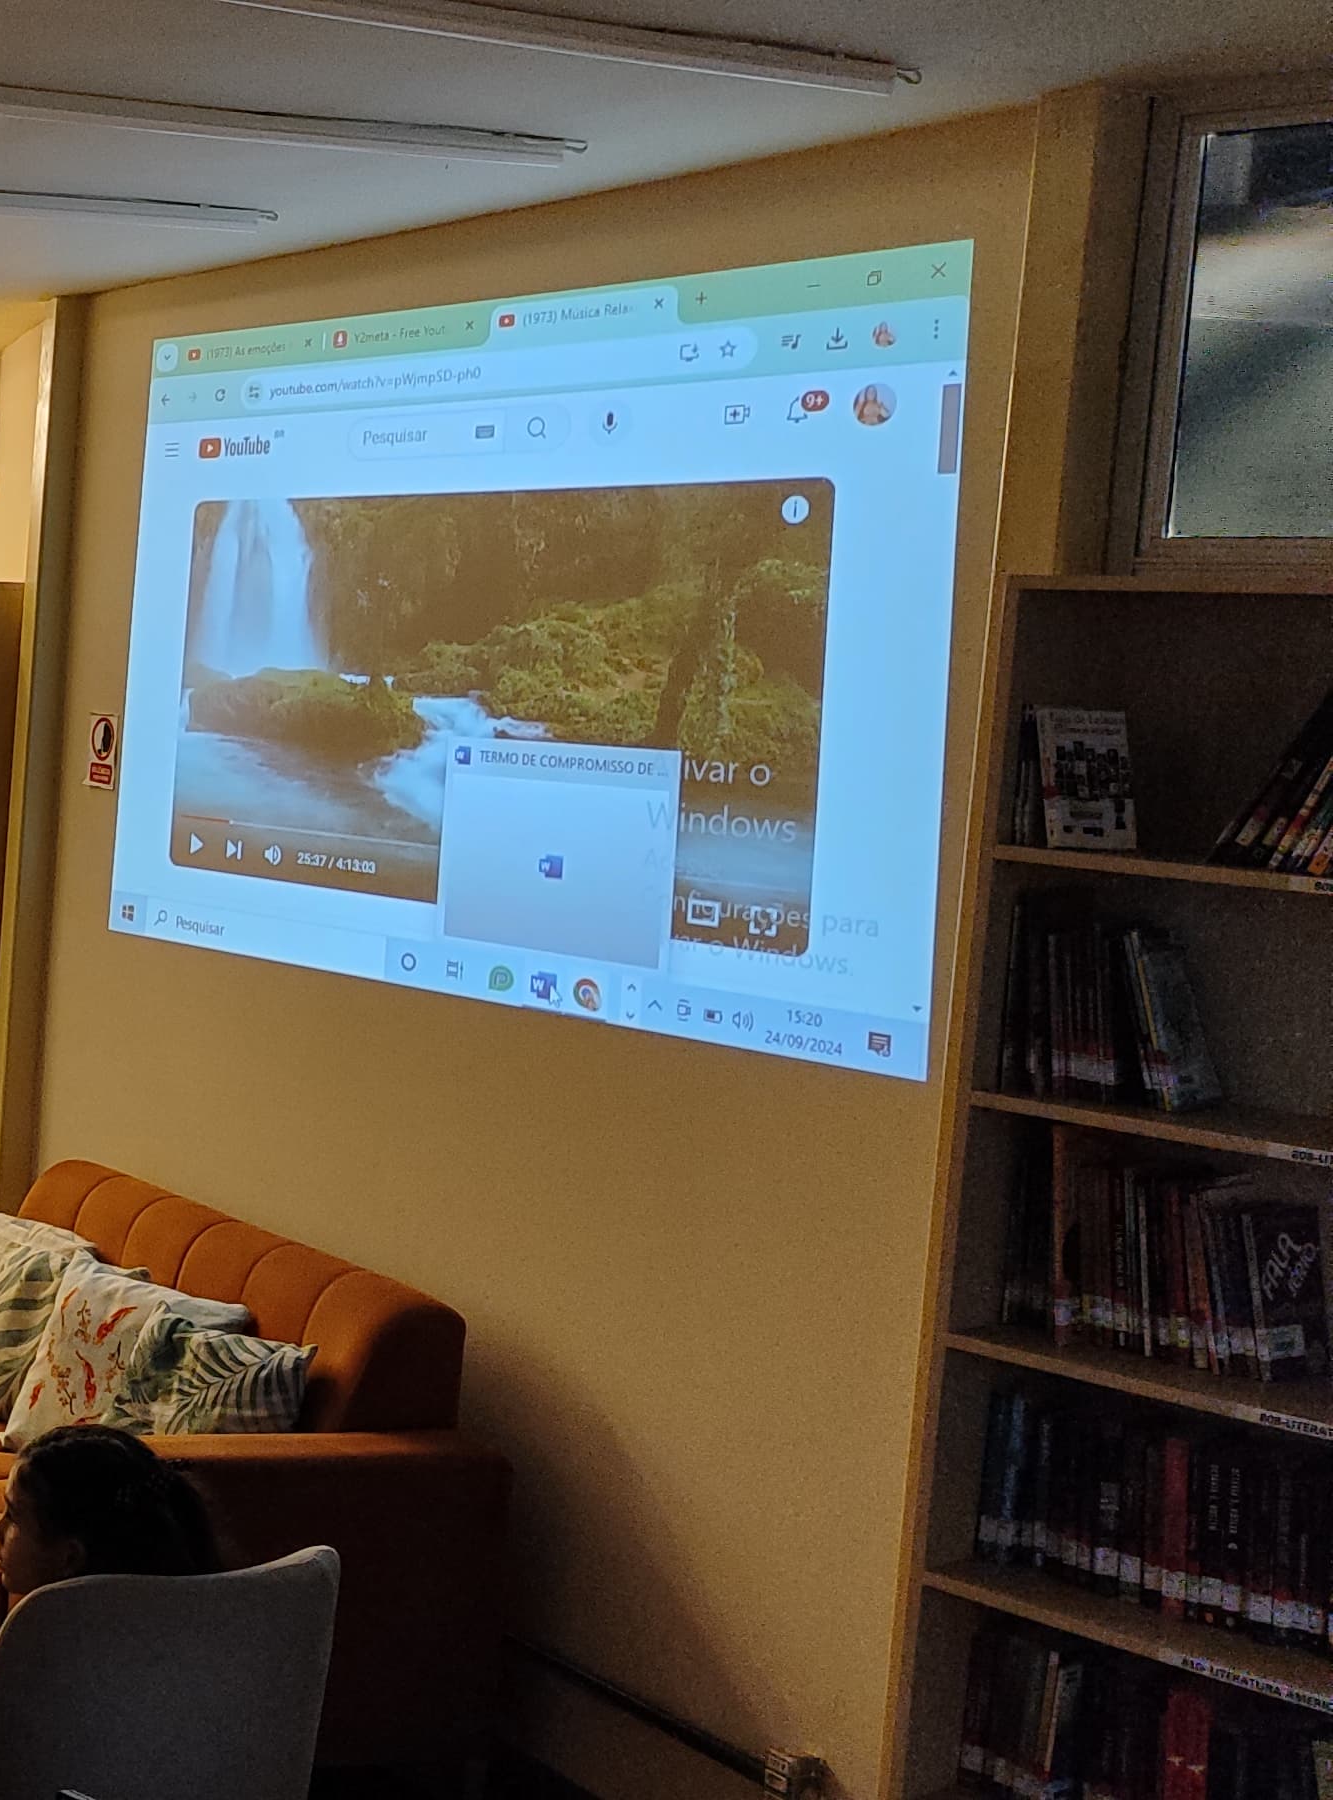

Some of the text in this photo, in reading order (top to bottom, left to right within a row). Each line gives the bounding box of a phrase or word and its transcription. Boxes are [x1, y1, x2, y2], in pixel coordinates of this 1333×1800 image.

[399, 326, 420, 340] Free
[223, 435, 271, 457] YouTube
[362, 429, 428, 449] Pesquisar
[479, 749, 519, 765] TERMO
[522, 752, 536, 767] DE
[539, 754, 635, 774] COMPROMISSO
[637, 761, 654, 776] DE
[749, 763, 772, 787] o
[646, 799, 798, 843] Windows
[175, 914, 225, 937] Pesquisar
[786, 1008, 823, 1028] 15:20
[764, 1029, 843, 1056] 24/09/2024
